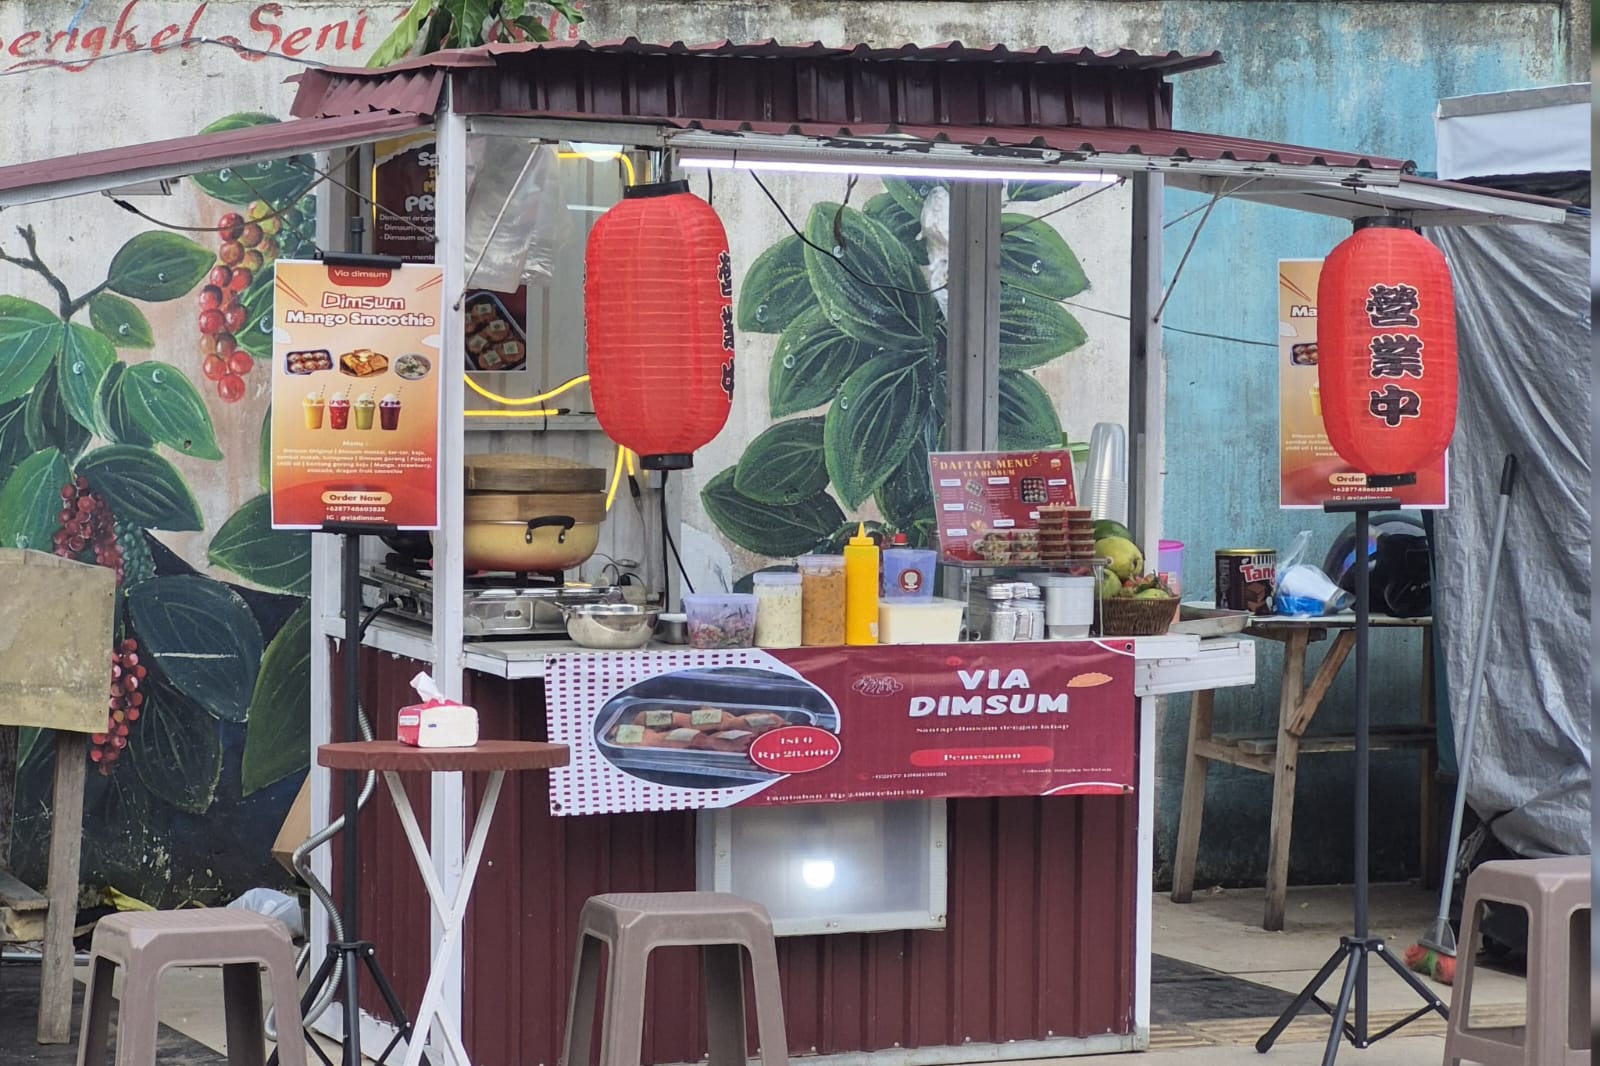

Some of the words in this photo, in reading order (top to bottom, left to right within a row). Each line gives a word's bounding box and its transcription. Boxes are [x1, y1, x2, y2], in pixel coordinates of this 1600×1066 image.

[0, 0, 206, 72] engkel
[218, 2, 367, 62] Seni
[351, 269, 388, 279] dimsum
[285, 309, 347, 327] Mango
[349, 311, 435, 327] Smoothie
[939, 458, 992, 471] DAFTAR
[995, 457, 1034, 470] MENU
[1336, 475, 1365, 483] Order
[359, 494, 383, 502] Now
[957, 668, 1031, 691] VIA
[908, 693, 1070, 718] DIMSUM
[758, 750, 781, 760] Rp
